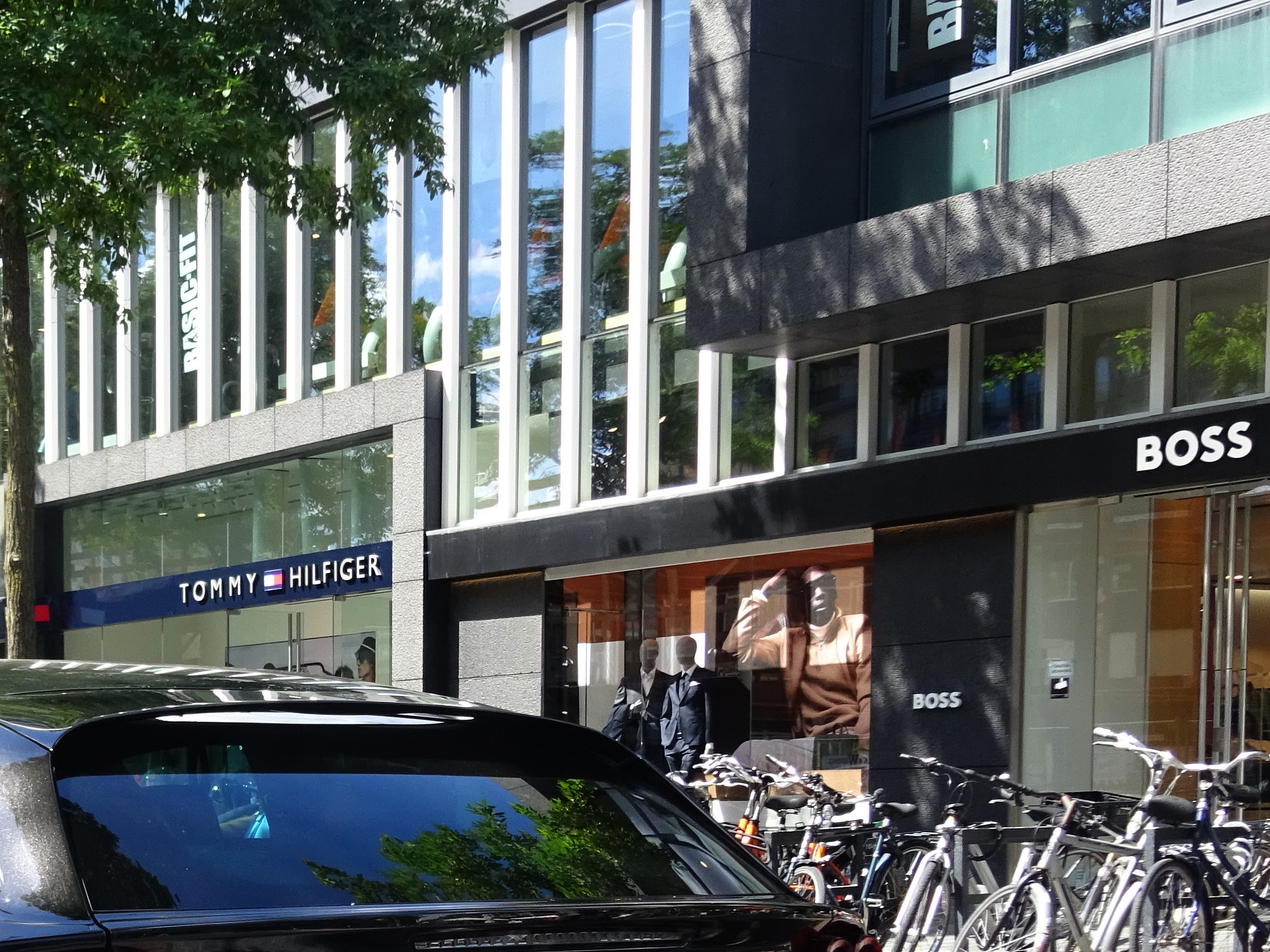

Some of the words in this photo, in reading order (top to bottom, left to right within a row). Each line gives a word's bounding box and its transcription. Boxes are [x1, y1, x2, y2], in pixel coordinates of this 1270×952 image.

[1136, 421, 1253, 472] BOSS
[179, 572, 257, 604] TOMMY
[289, 553, 383, 589] HILFIGER
[912, 691, 963, 710] BOSS
